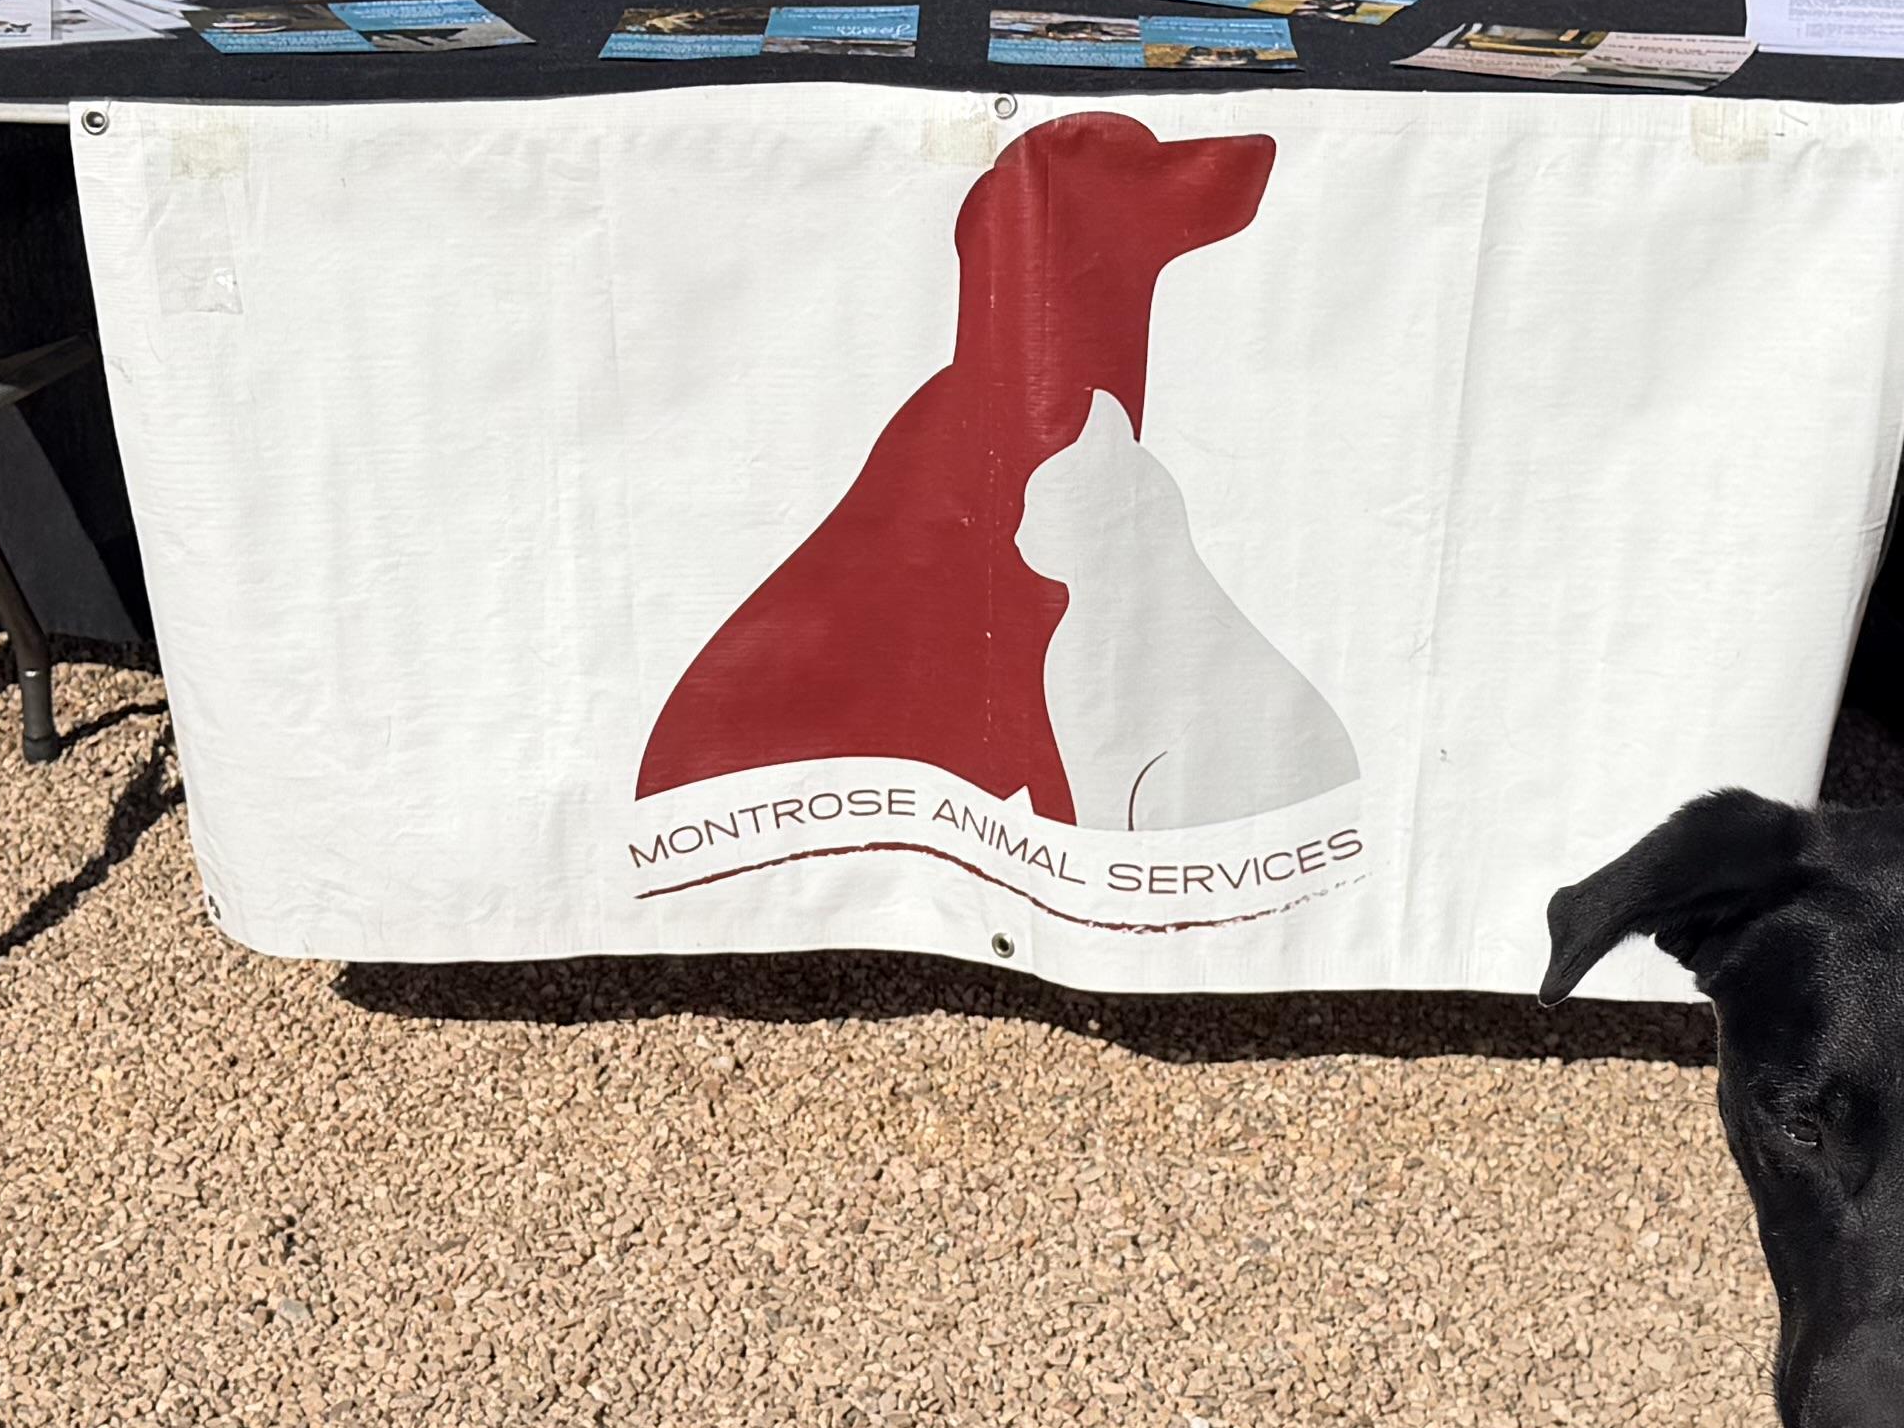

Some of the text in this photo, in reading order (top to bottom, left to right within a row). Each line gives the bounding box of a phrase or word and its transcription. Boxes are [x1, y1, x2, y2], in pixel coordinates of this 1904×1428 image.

[628, 788, 1363, 895] MONTROSE ANIMAL SERVICES
